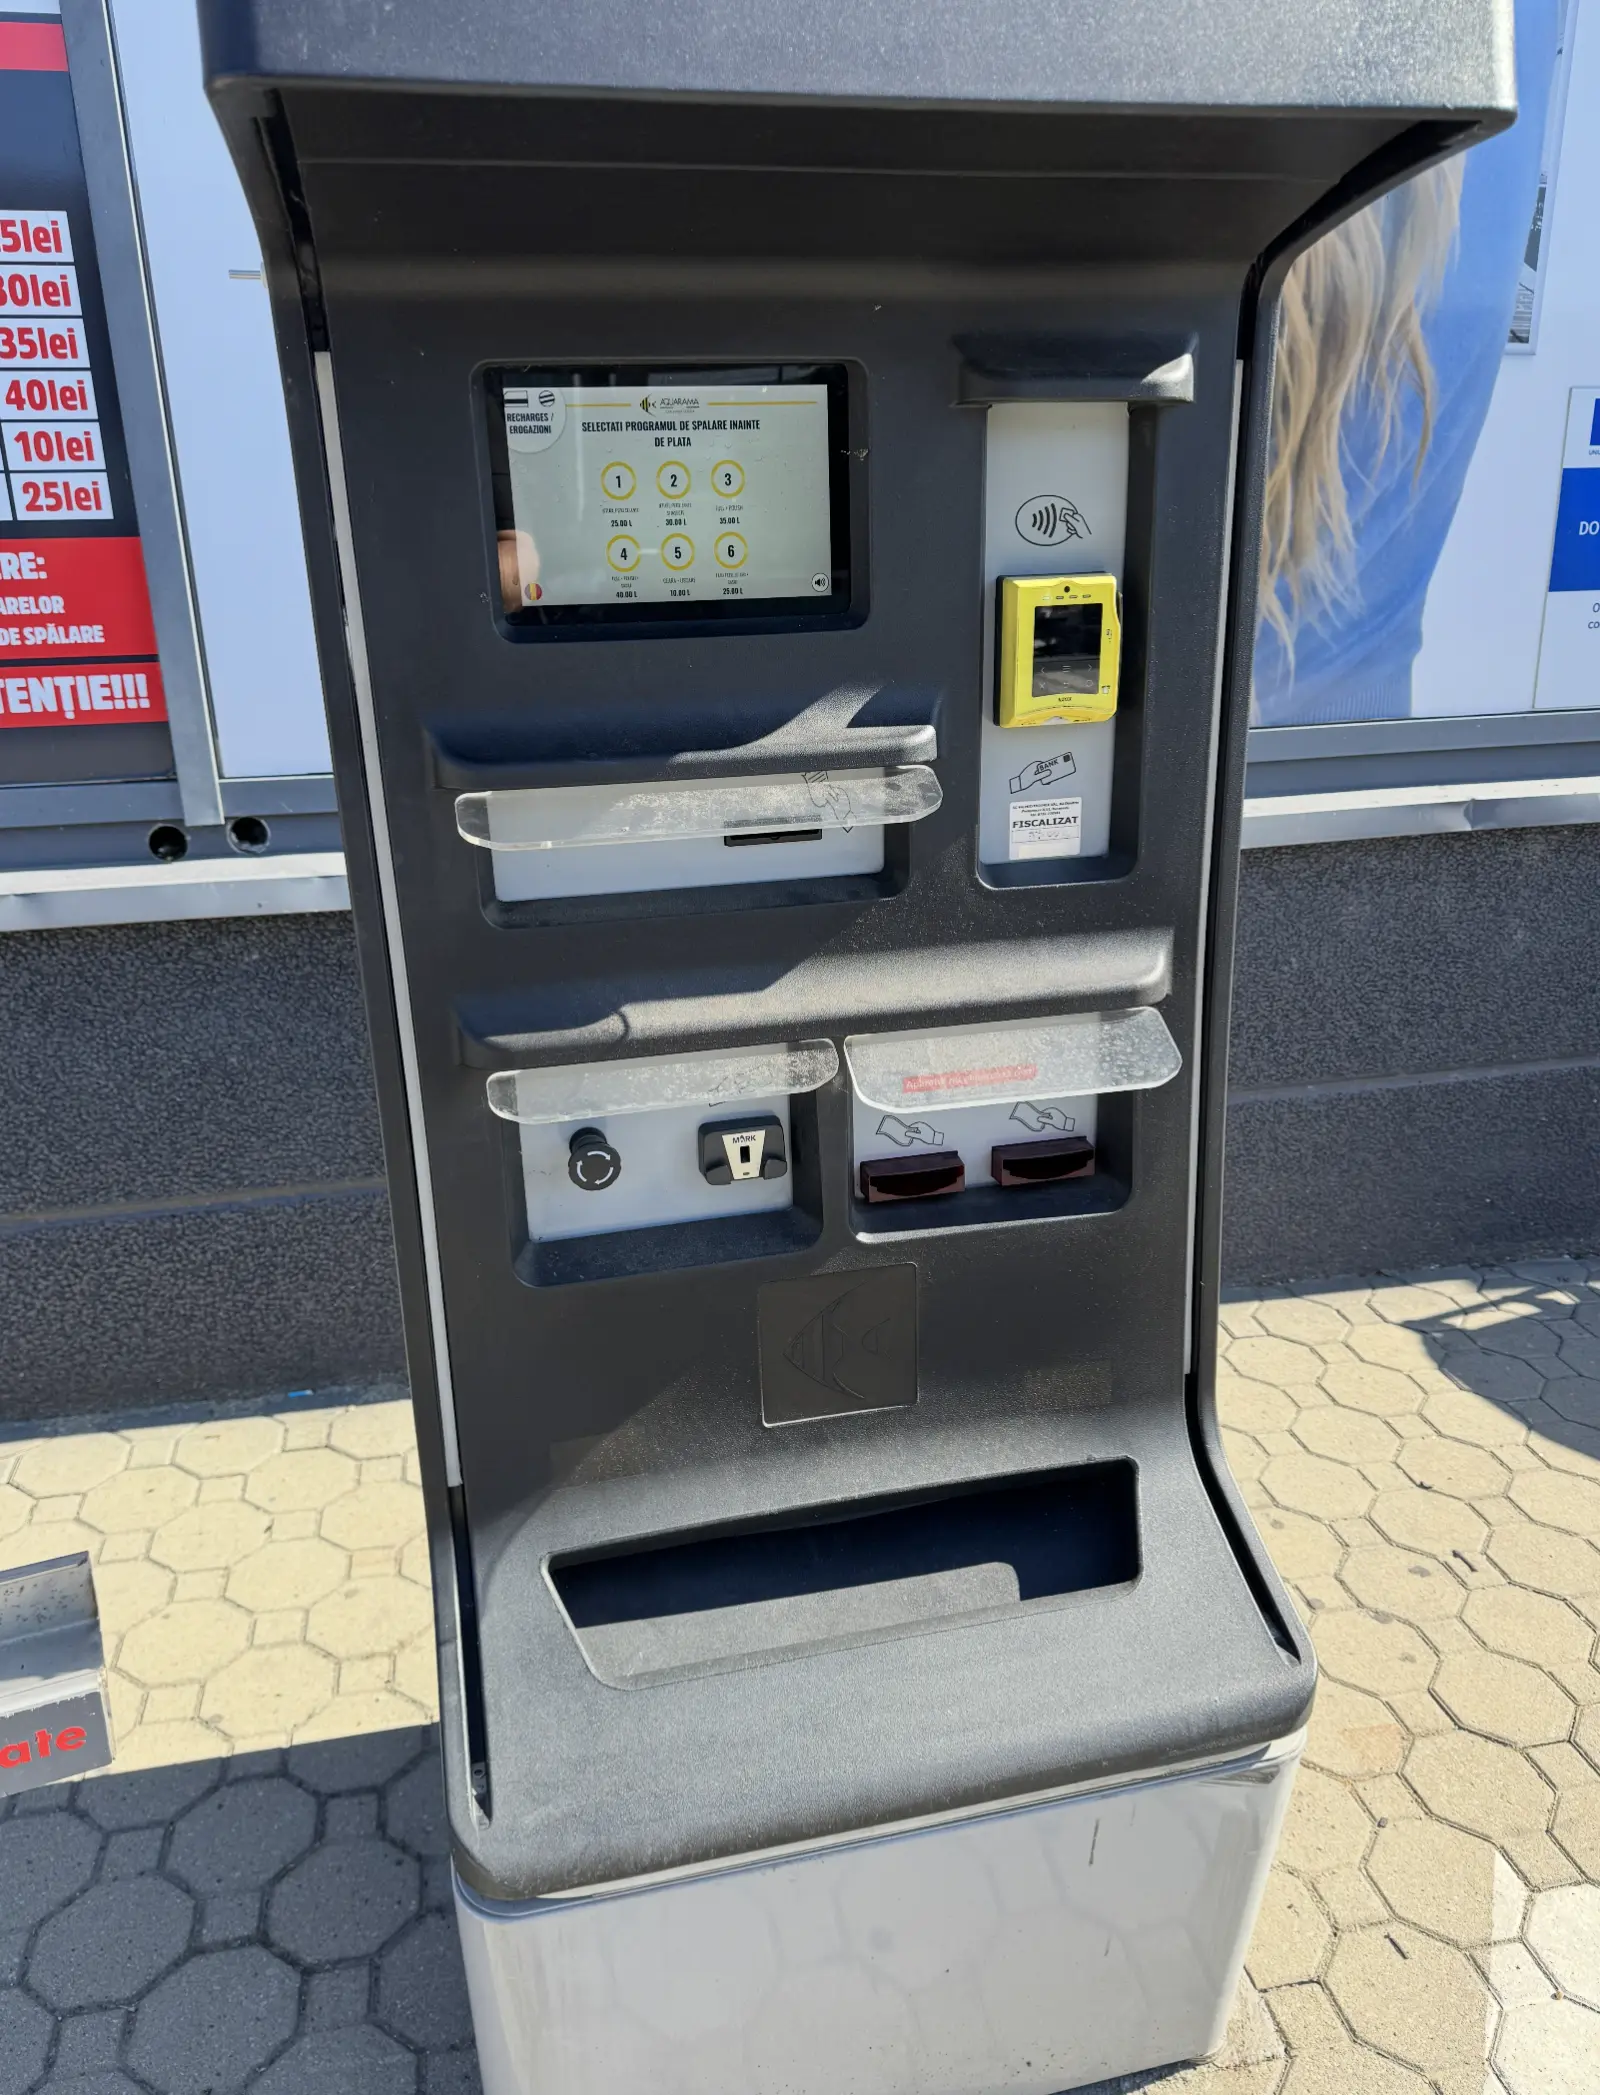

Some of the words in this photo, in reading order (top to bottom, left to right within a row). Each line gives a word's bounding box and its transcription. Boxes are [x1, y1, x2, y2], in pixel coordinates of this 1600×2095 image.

[0, 327, 79, 360] 35lei
[5, 379, 89, 411] 40lei
[506, 413, 549, 422] RECHARGES
[509, 424, 552, 434] EROGAZIONI
[581, 421, 623, 432] SELECTATI
[625, 420, 677, 432] PROGRAMUL
[679, 420, 690, 431] DE
[691, 420, 728, 431] SPALARE
[729, 419, 761, 430] INAINTE
[14, 430, 95, 462] 10lei
[654, 436, 665, 447] DE
[667, 436, 692, 447] PLATA
[615, 475, 621, 488] 1
[670, 474, 678, 487] 2
[724, 473, 732, 486] 3
[22, 481, 103, 512] 25lei
[719, 517, 736, 525] 35.00
[620, 547, 628, 560] 4
[674, 546, 682, 559] 5
[727, 545, 735, 558] 6
[616, 590, 633, 598] 40.00
[23, 623, 105, 646] SPĂLARE
[1040, 759, 1059, 771] BANK
[1012, 815, 1079, 829] FISCALIZAT
[0, 1726, 87, 1769] ate
